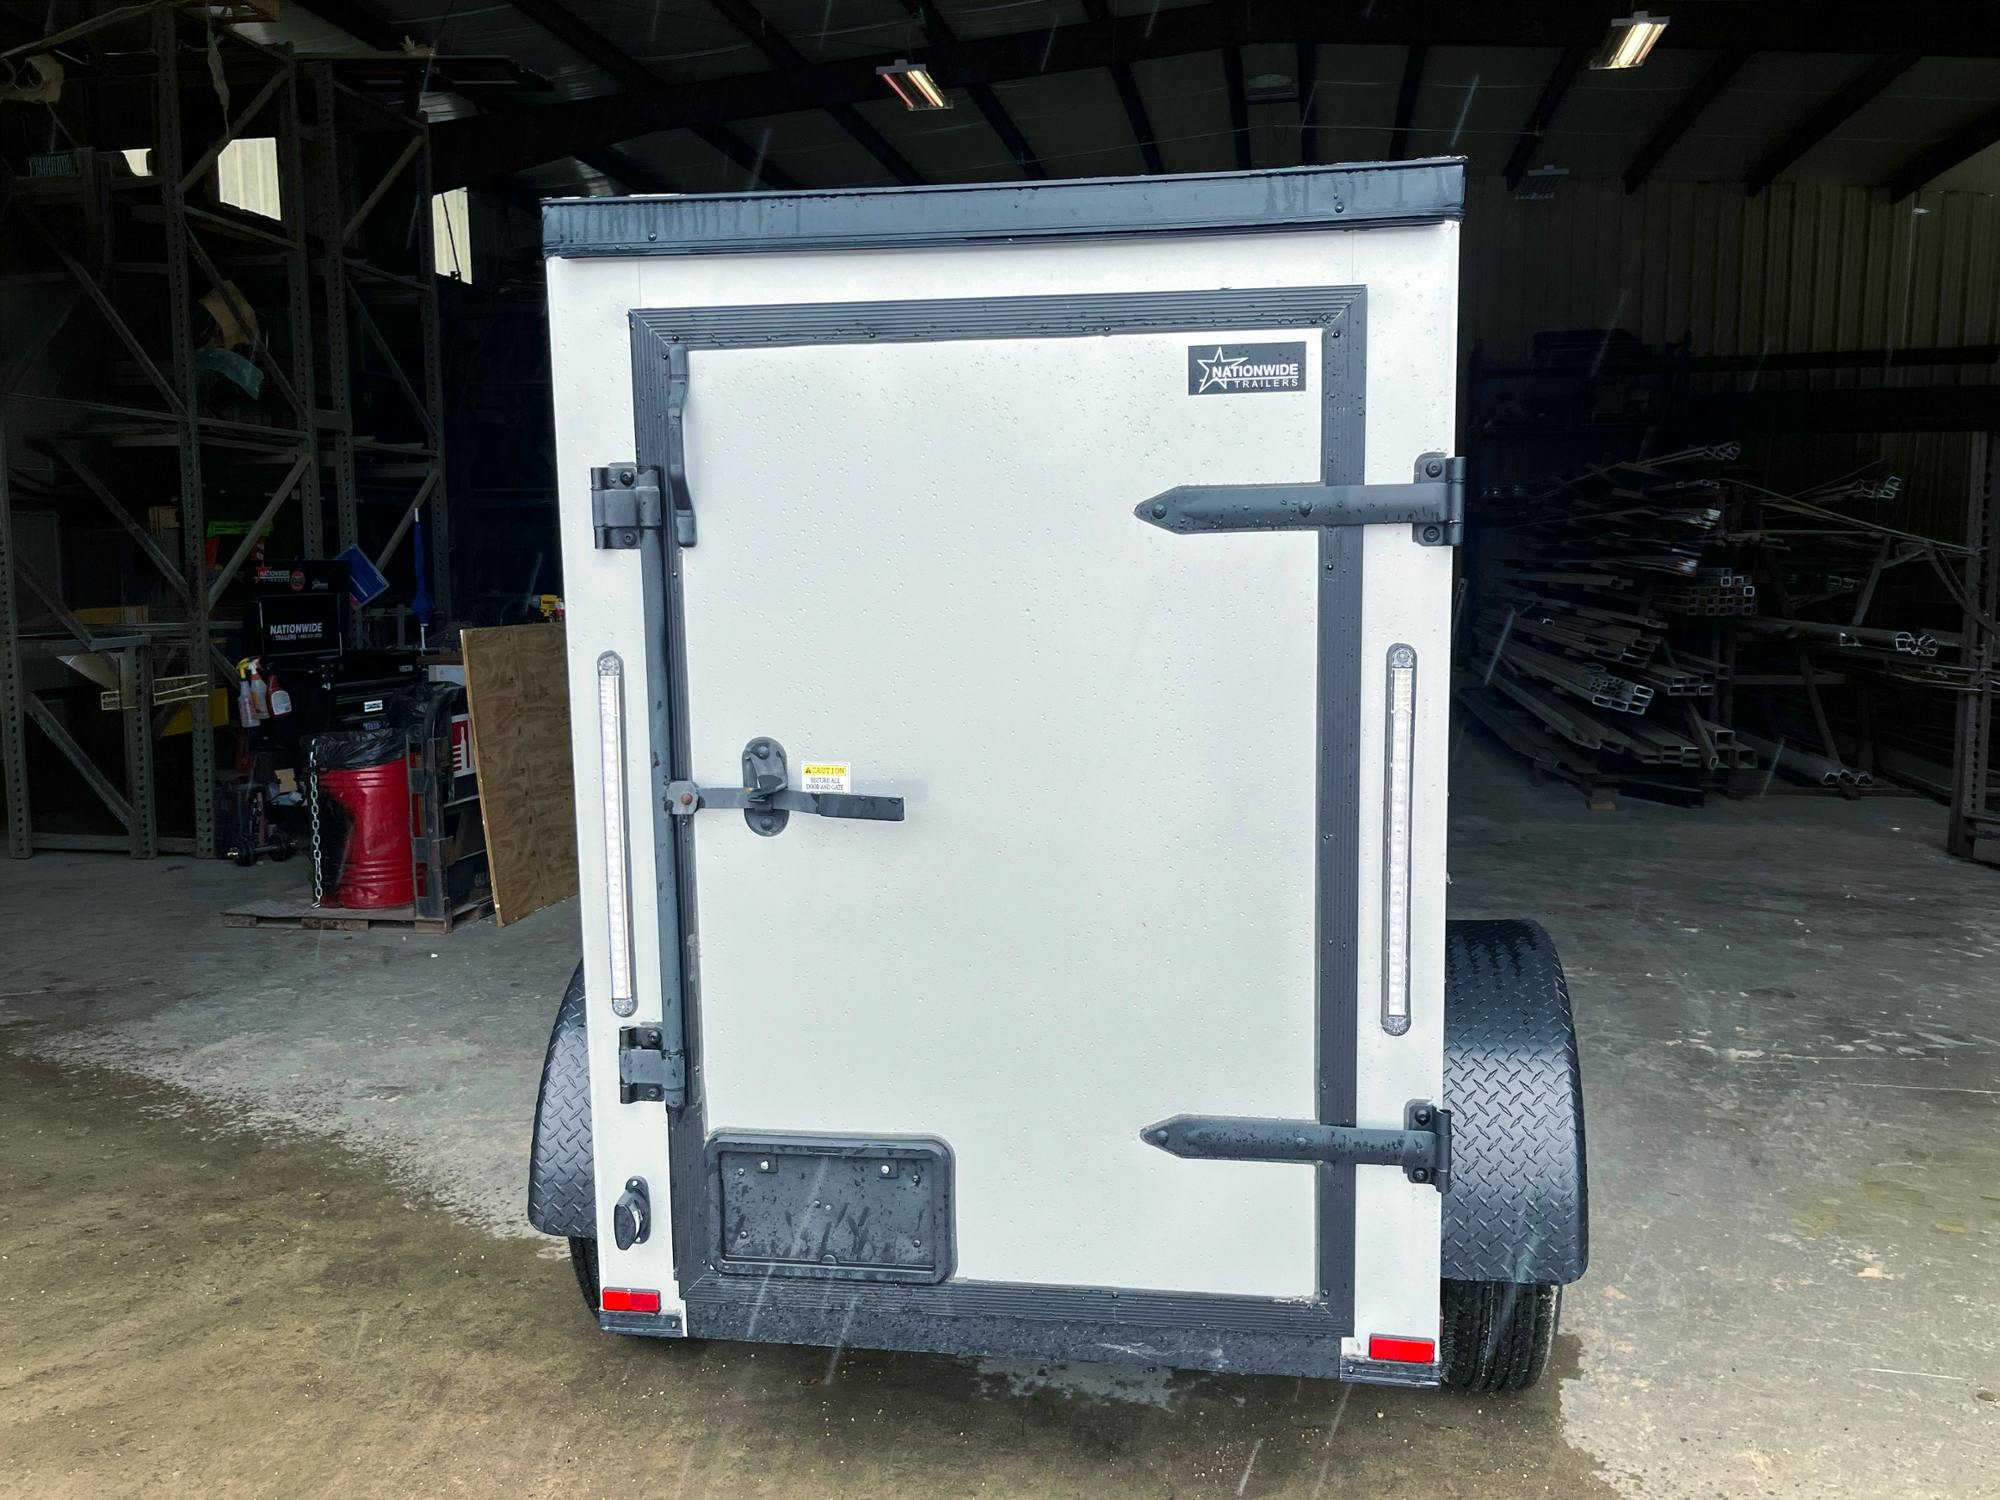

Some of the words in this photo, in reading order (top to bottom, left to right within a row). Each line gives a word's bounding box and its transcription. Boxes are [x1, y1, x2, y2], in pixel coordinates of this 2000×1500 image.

[1212, 363, 1298, 378] NATIONWIDE
[1234, 379, 1298, 389] TRAILERS
[270, 622, 323, 635] NATIONWIDE
